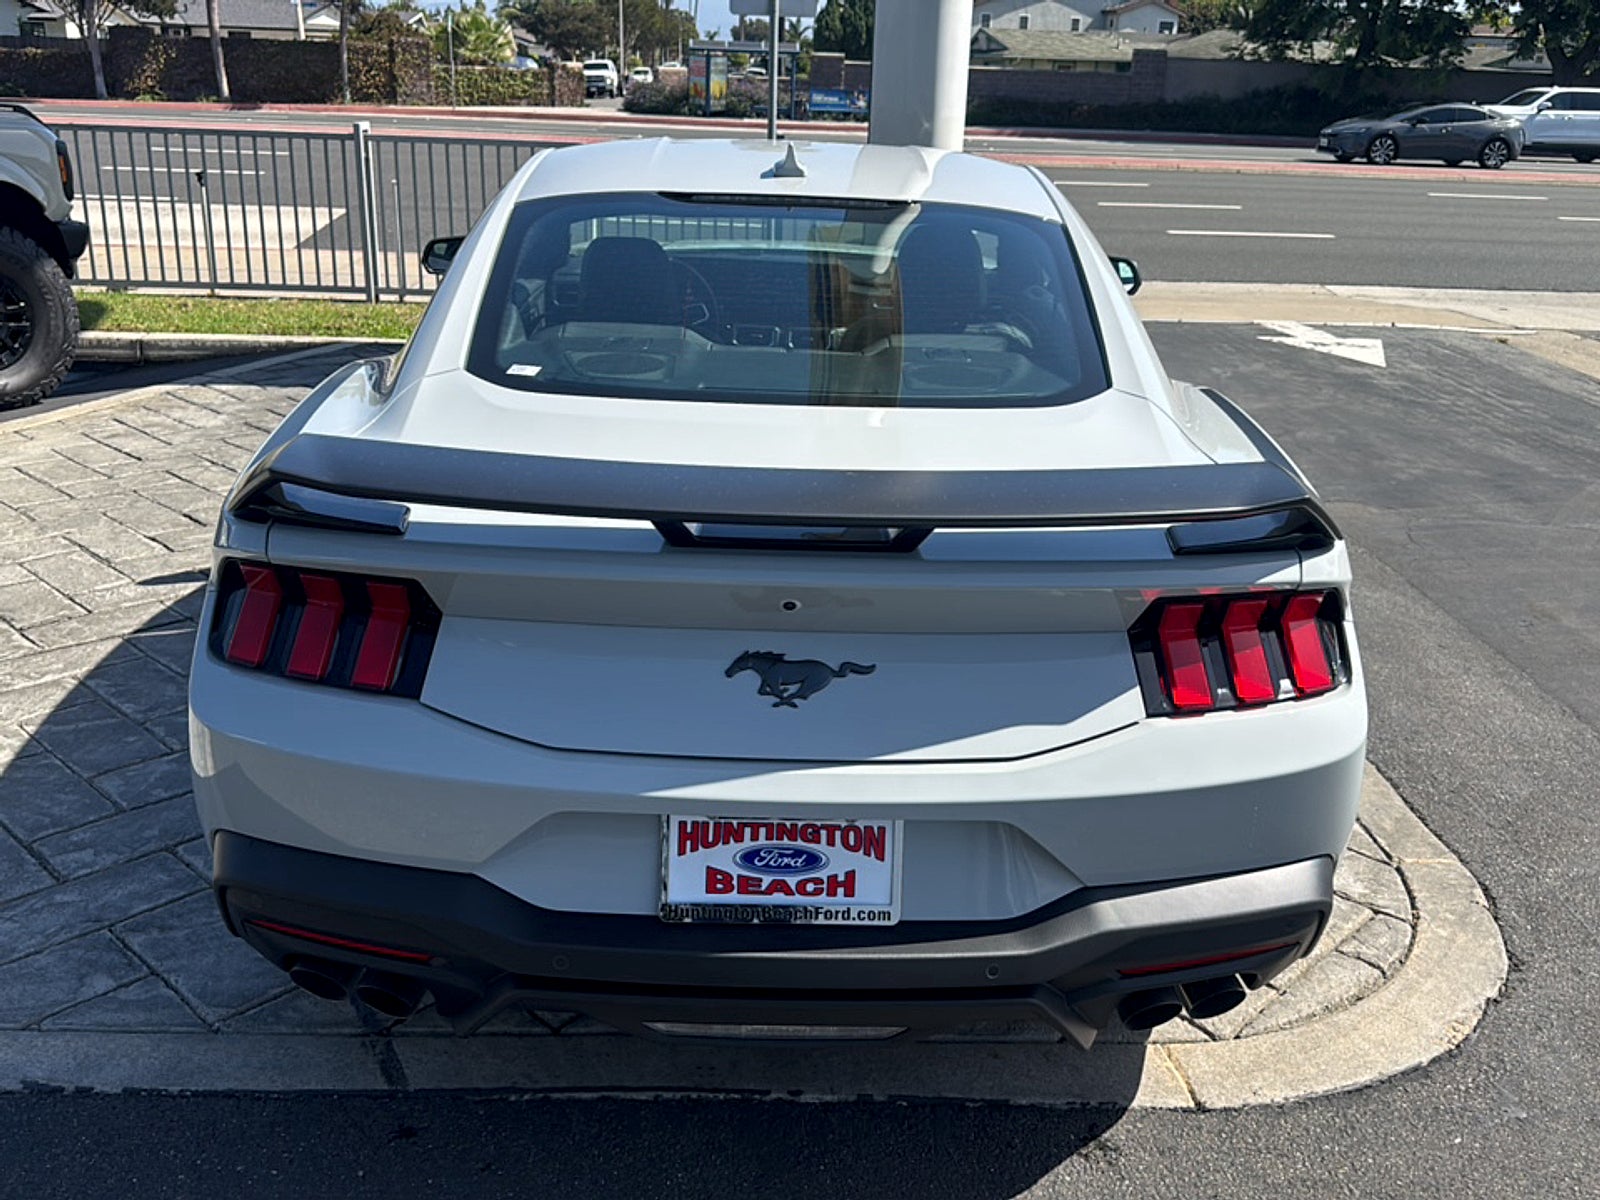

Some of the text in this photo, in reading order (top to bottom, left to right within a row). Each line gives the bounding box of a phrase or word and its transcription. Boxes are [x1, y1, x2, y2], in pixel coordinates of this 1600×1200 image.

[677, 820, 886, 862] HUNTINGTON
[754, 848, 807, 867] Ford
[705, 865, 856, 898] BEACH
